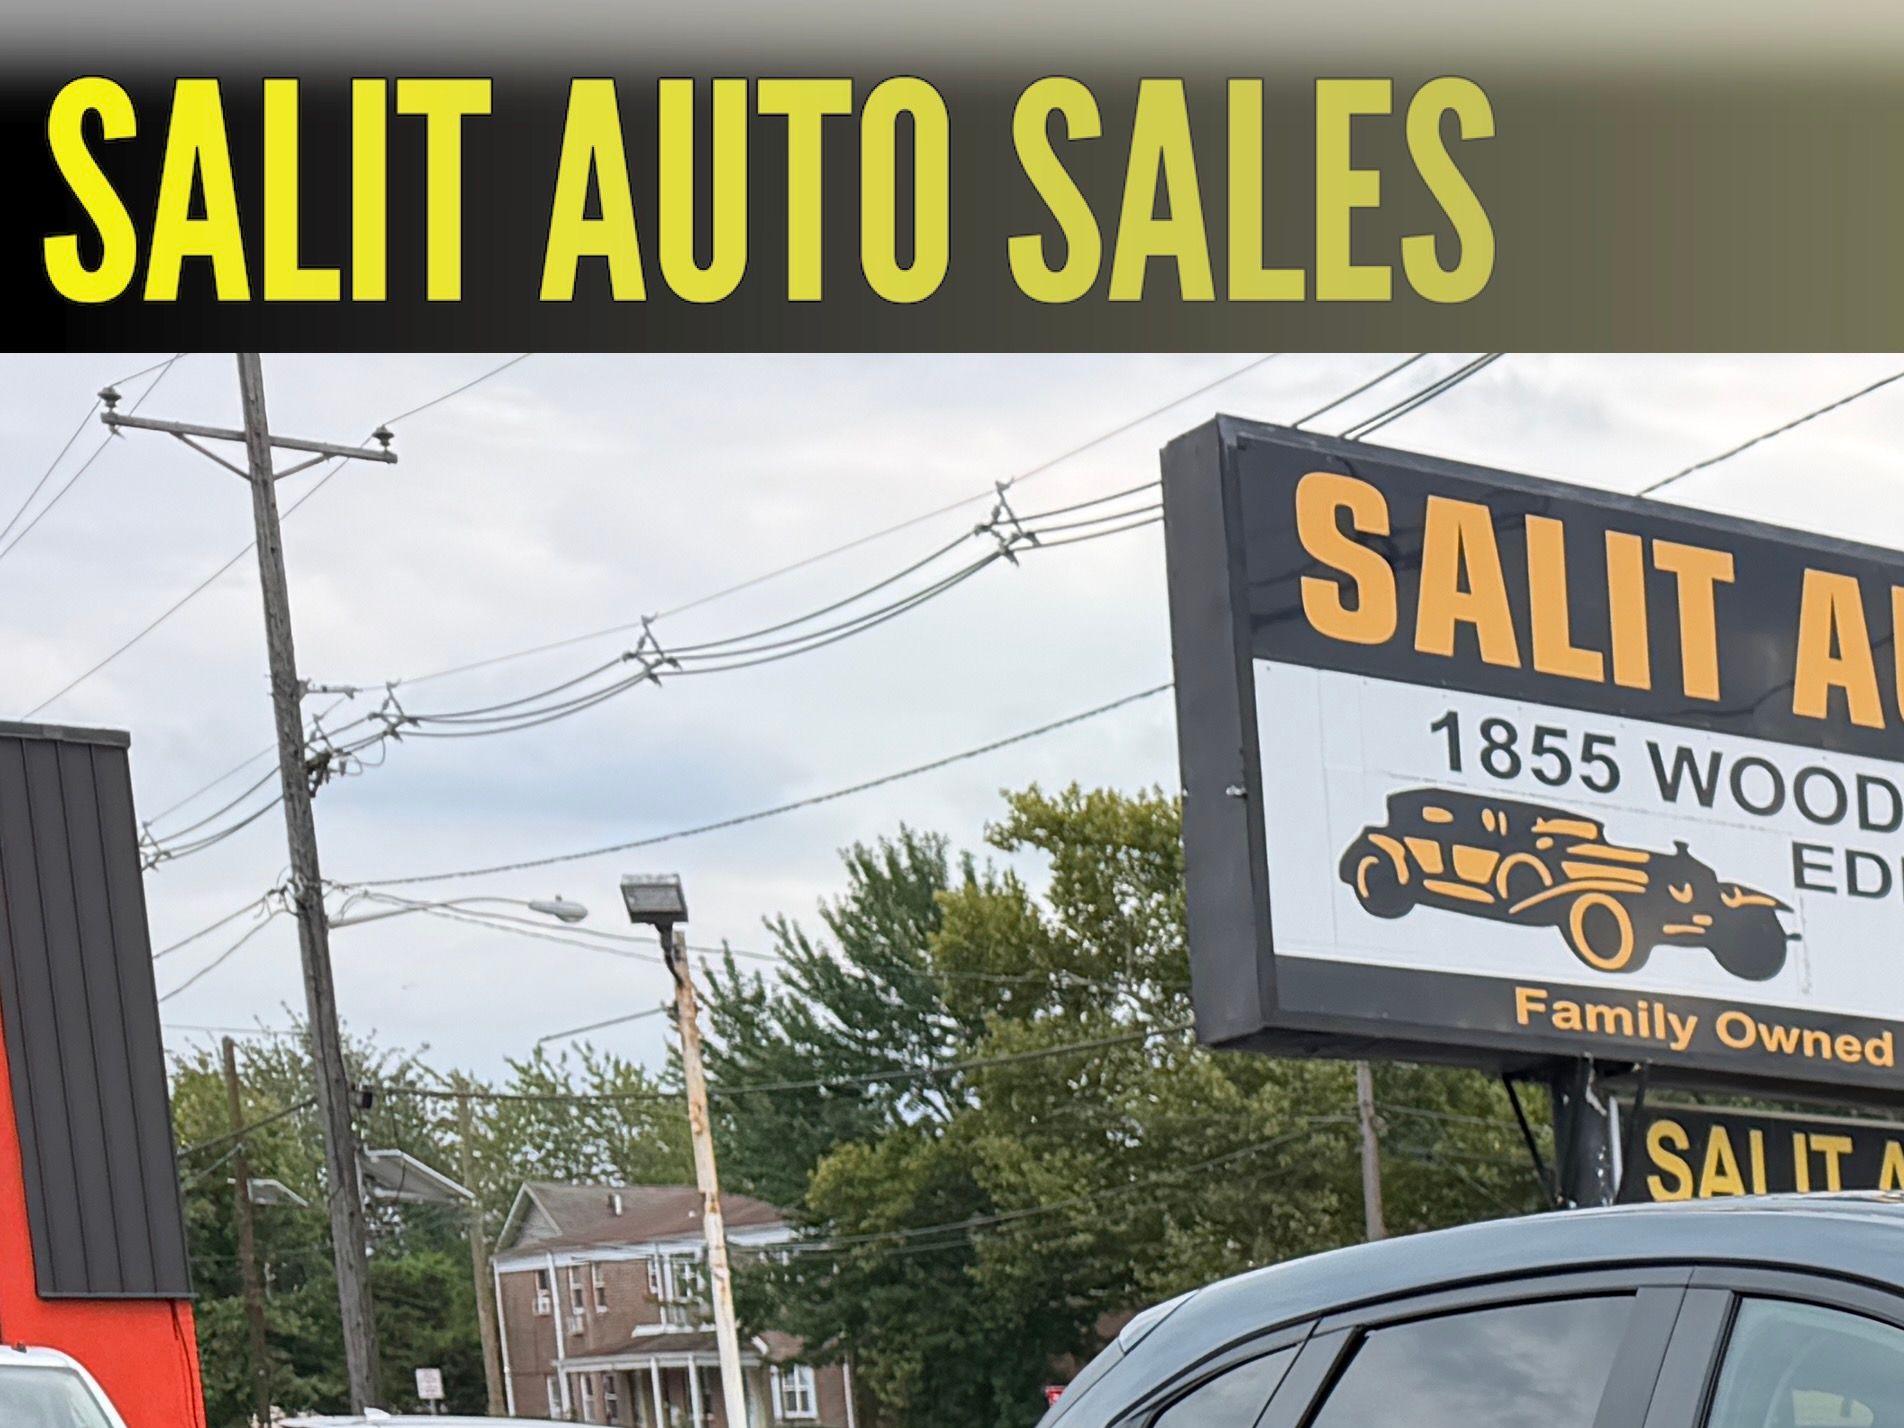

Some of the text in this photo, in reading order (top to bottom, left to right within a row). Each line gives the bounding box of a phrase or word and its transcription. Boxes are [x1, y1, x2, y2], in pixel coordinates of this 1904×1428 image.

[1295, 471, 1736, 702] SALIT
[1430, 710, 1622, 794] 1855
[1515, 987, 1698, 1053] Family
[1716, 1011, 1896, 1068] Owned
